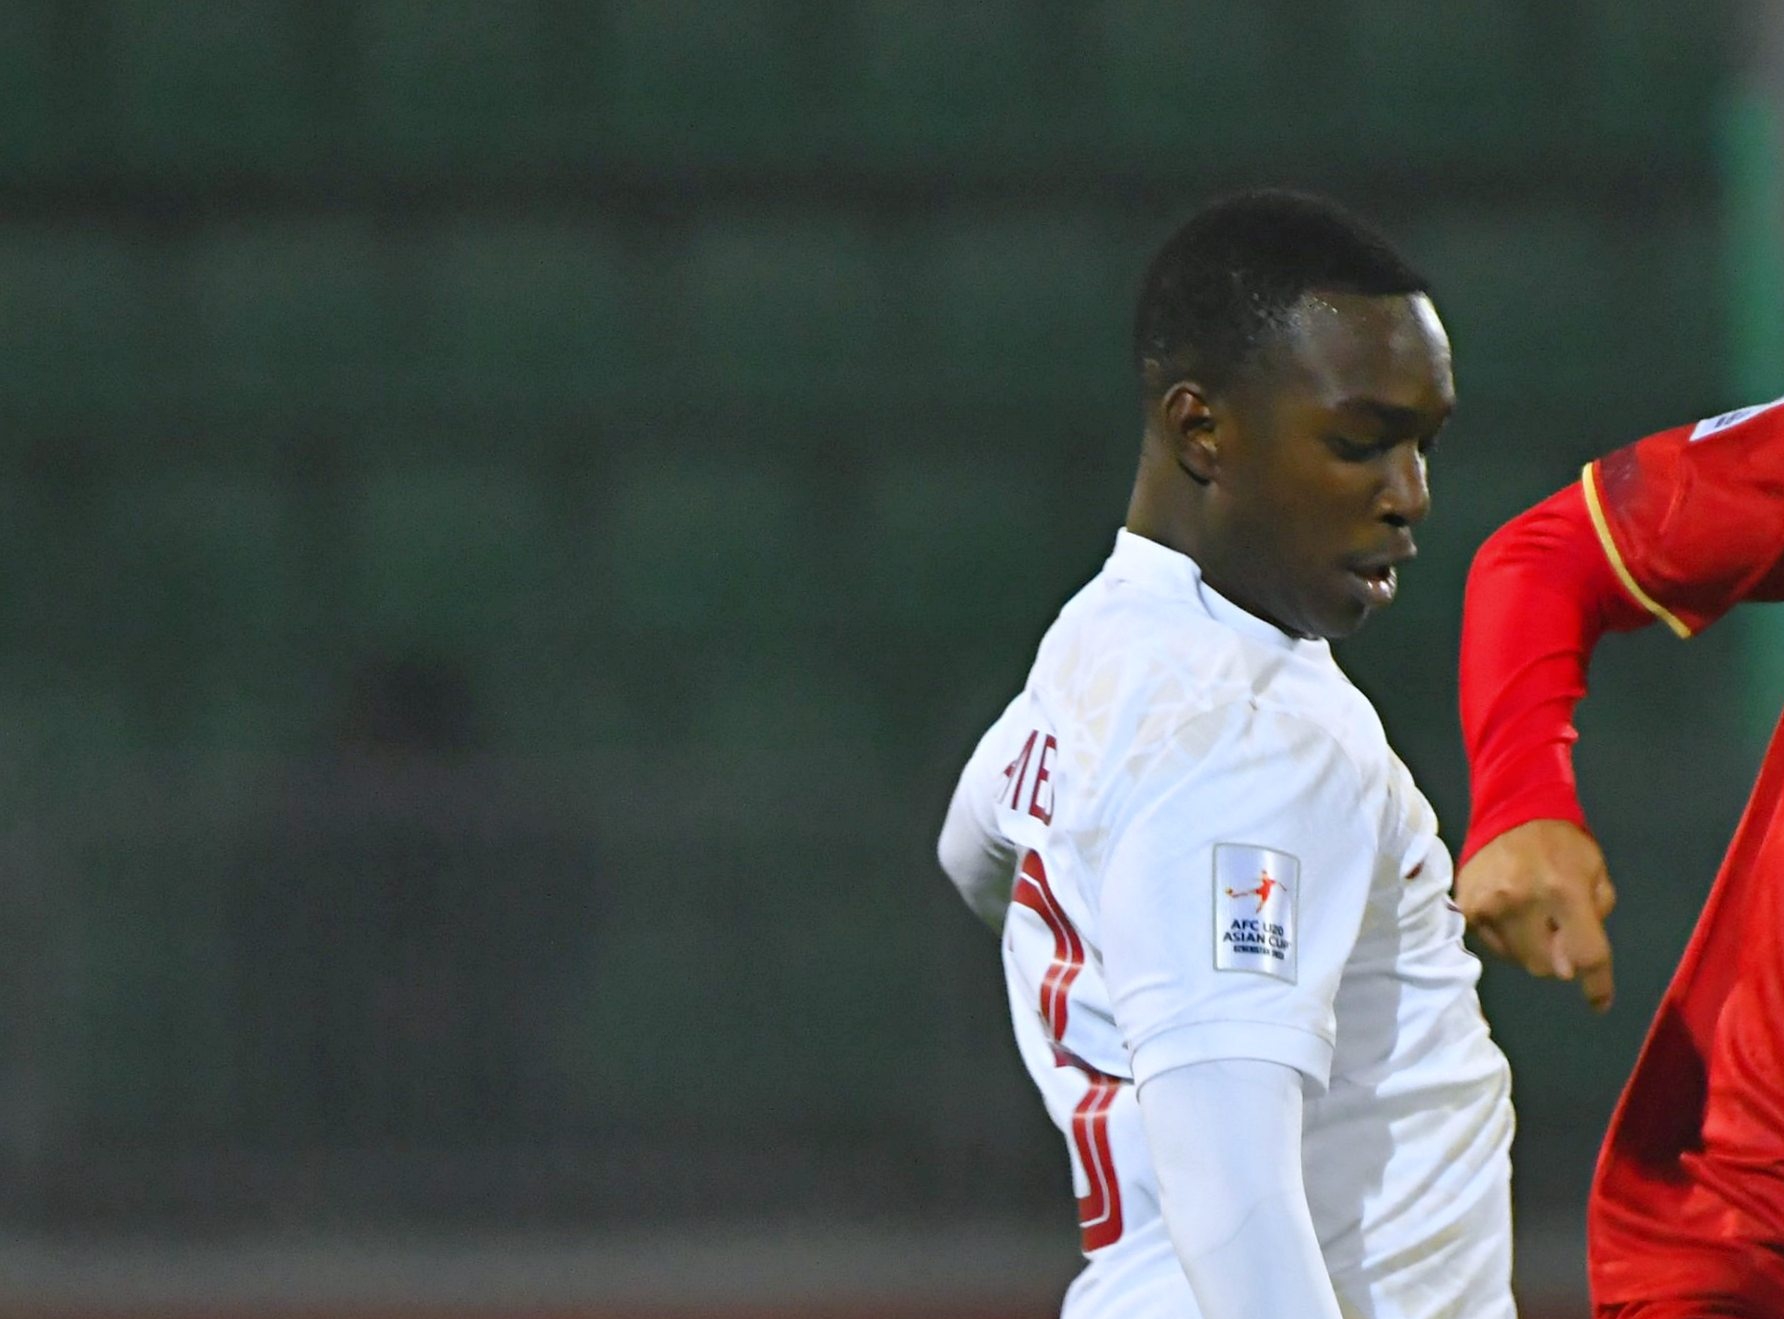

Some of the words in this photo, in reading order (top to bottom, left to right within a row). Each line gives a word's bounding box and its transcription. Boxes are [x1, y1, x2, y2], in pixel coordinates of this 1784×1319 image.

[1231, 919, 1259, 932] AFC
[1223, 932, 1265, 944] ASIAN
[1268, 937, 1289, 949] CUP
